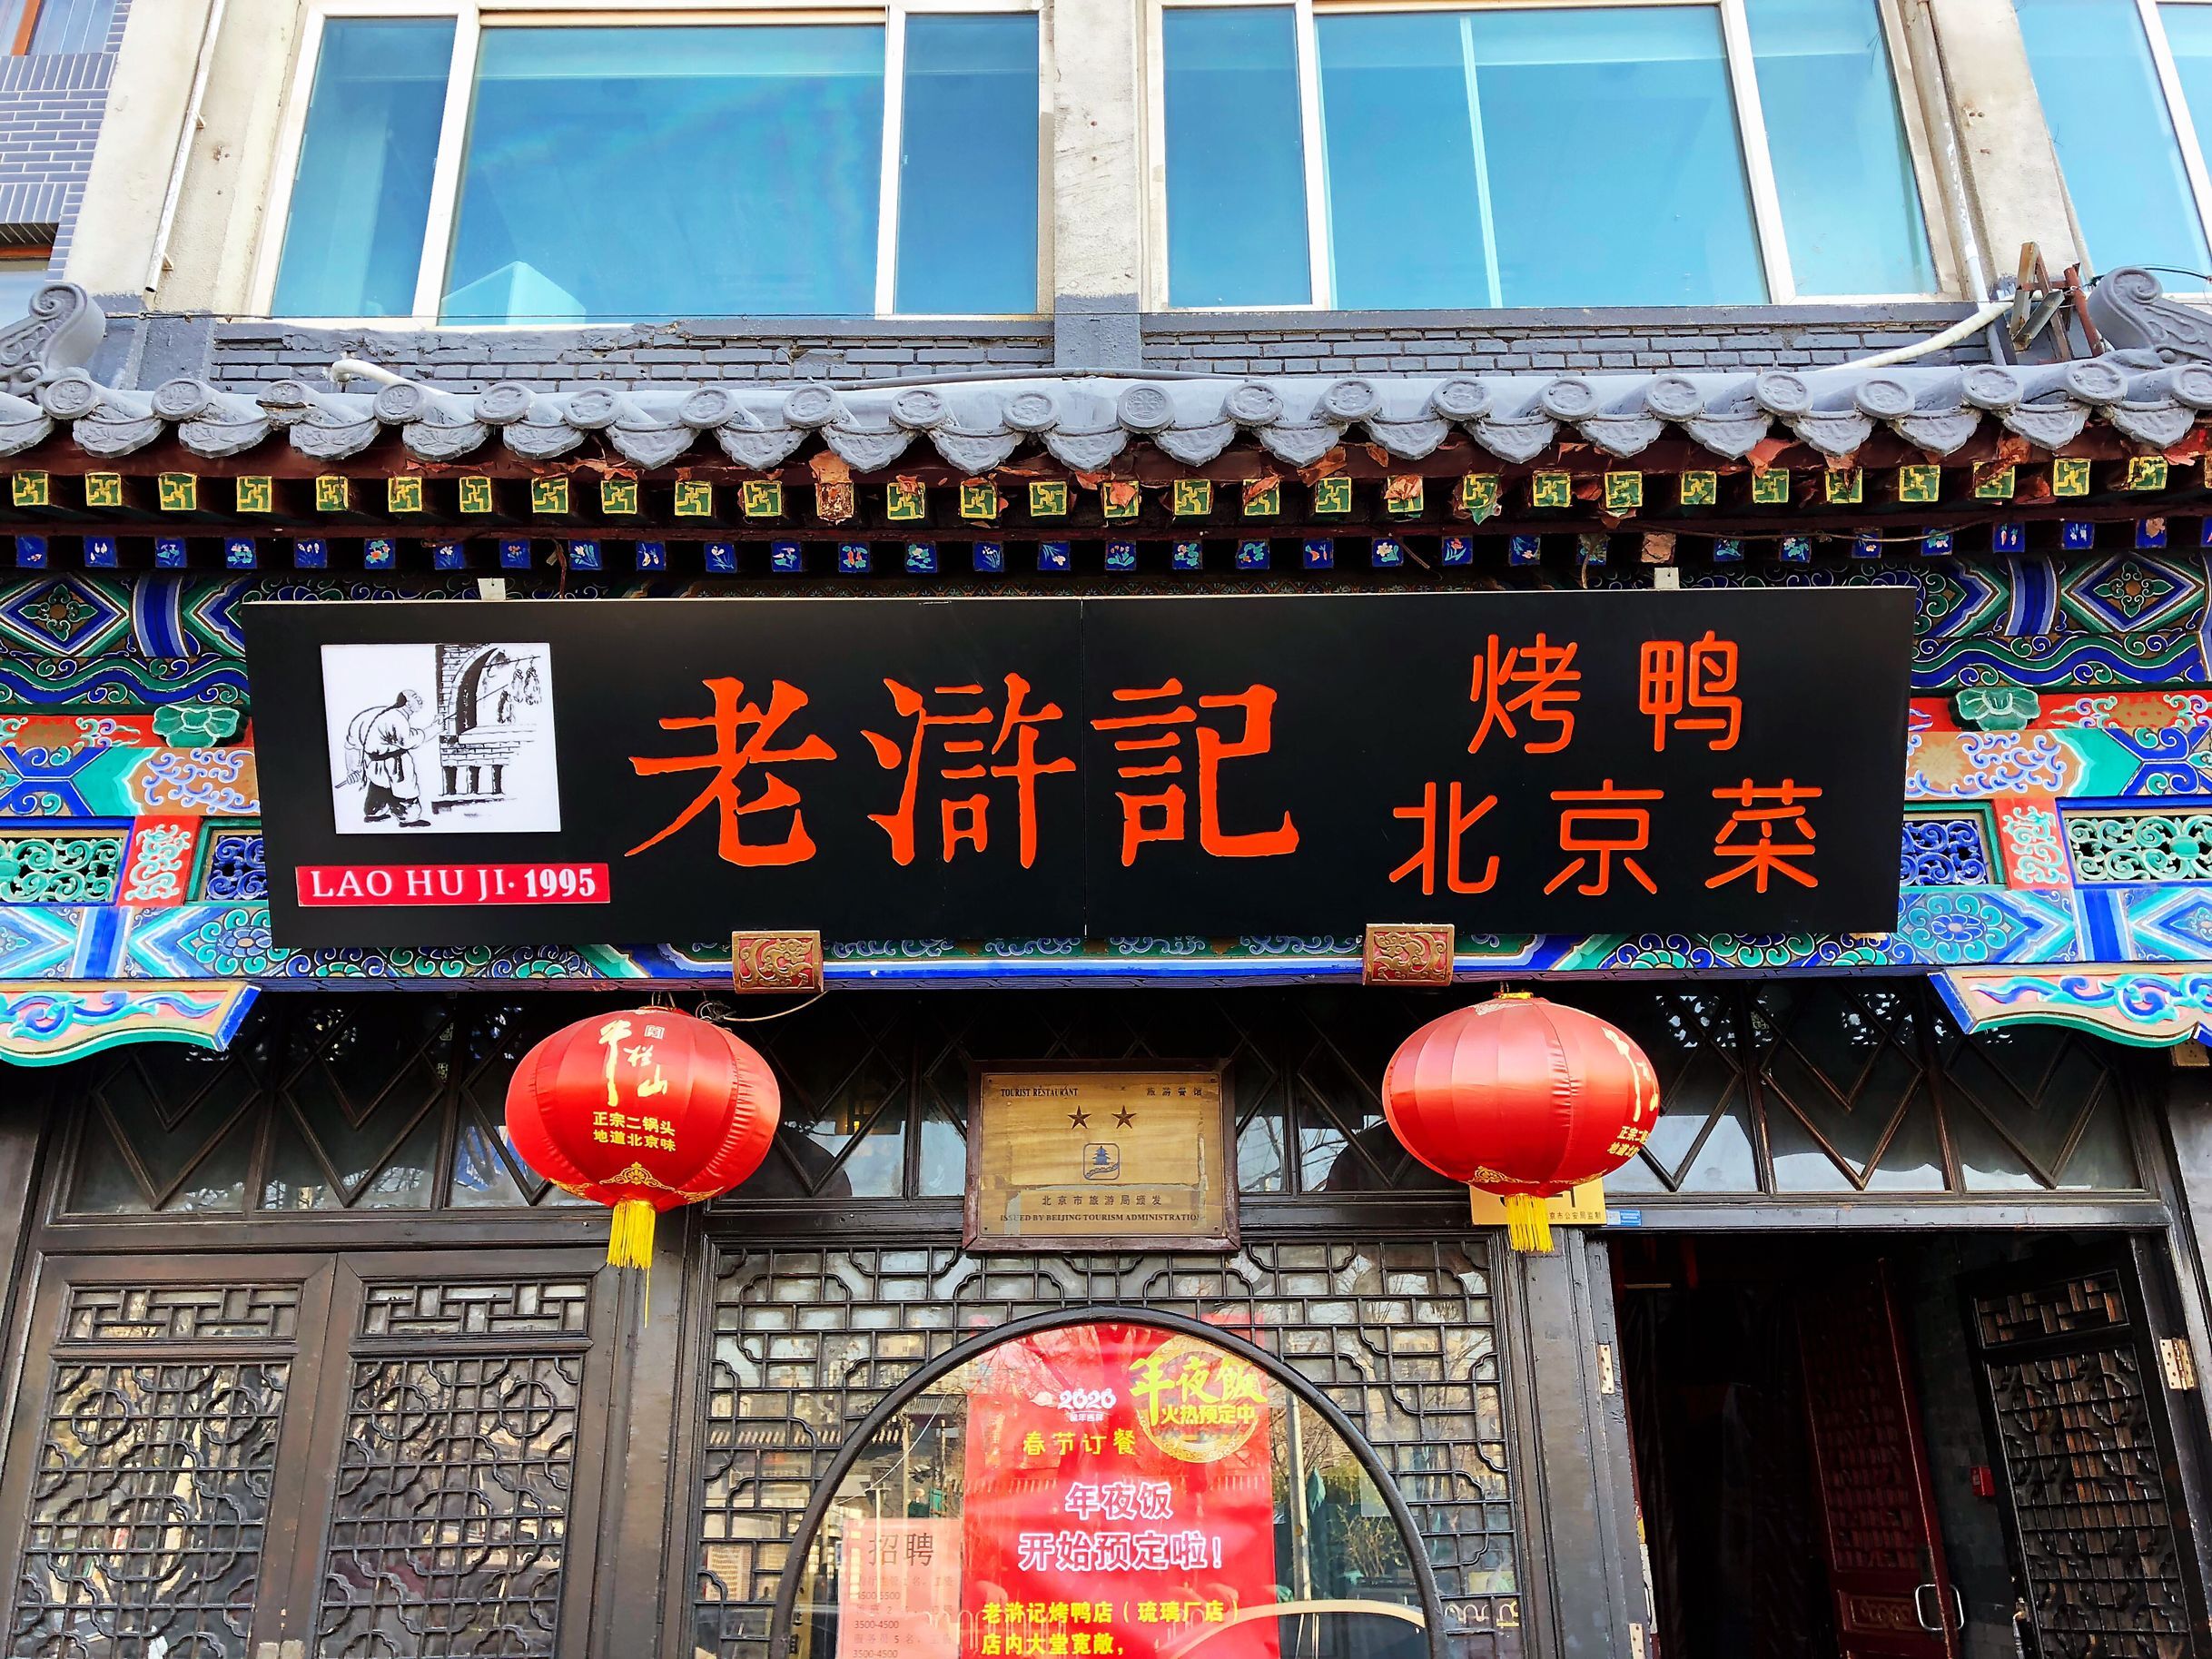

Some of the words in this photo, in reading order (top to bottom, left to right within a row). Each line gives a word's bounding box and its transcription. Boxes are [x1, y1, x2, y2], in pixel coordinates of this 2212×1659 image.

[1468, 629, 1743, 756] 烤鸭
[627, 672, 1299, 868] 老滸記
[1388, 777, 1823, 897] 北京菜
[311, 870, 392, 898] LAO
[406, 869, 465, 897] HU
[523, 867, 597, 897] 1995
[1001, 1087, 1031, 1097] TOURIST
[1032, 1087, 1079, 1097] RESTAURANT
[1146, 1086, 1203, 1097] 旅游餐馆
[592, 1111, 676, 1137] 正宗二锅头
[592, 1129, 676, 1152] 地道北京味
[1042, 1195, 1162, 1207] 北京市旅游局颁发
[1000, 1213, 1032, 1222] ISSUED
[1032, 1213, 1045, 1222] BY
[1046, 1213, 1081, 1222] BEIJING
[1083, 1213, 1123, 1222] TOURISM
[1548, 1210, 1602, 1220] 京市公安局监制
[1057, 1387, 1117, 1409] 2020
[1160, 1405, 1255, 1426] 火热预定中
[1022, 1427, 1136, 1457] 春节订餐
[1064, 1481, 1174, 1521] 年夜饭
[867, 1532, 934, 1567] 招聘
